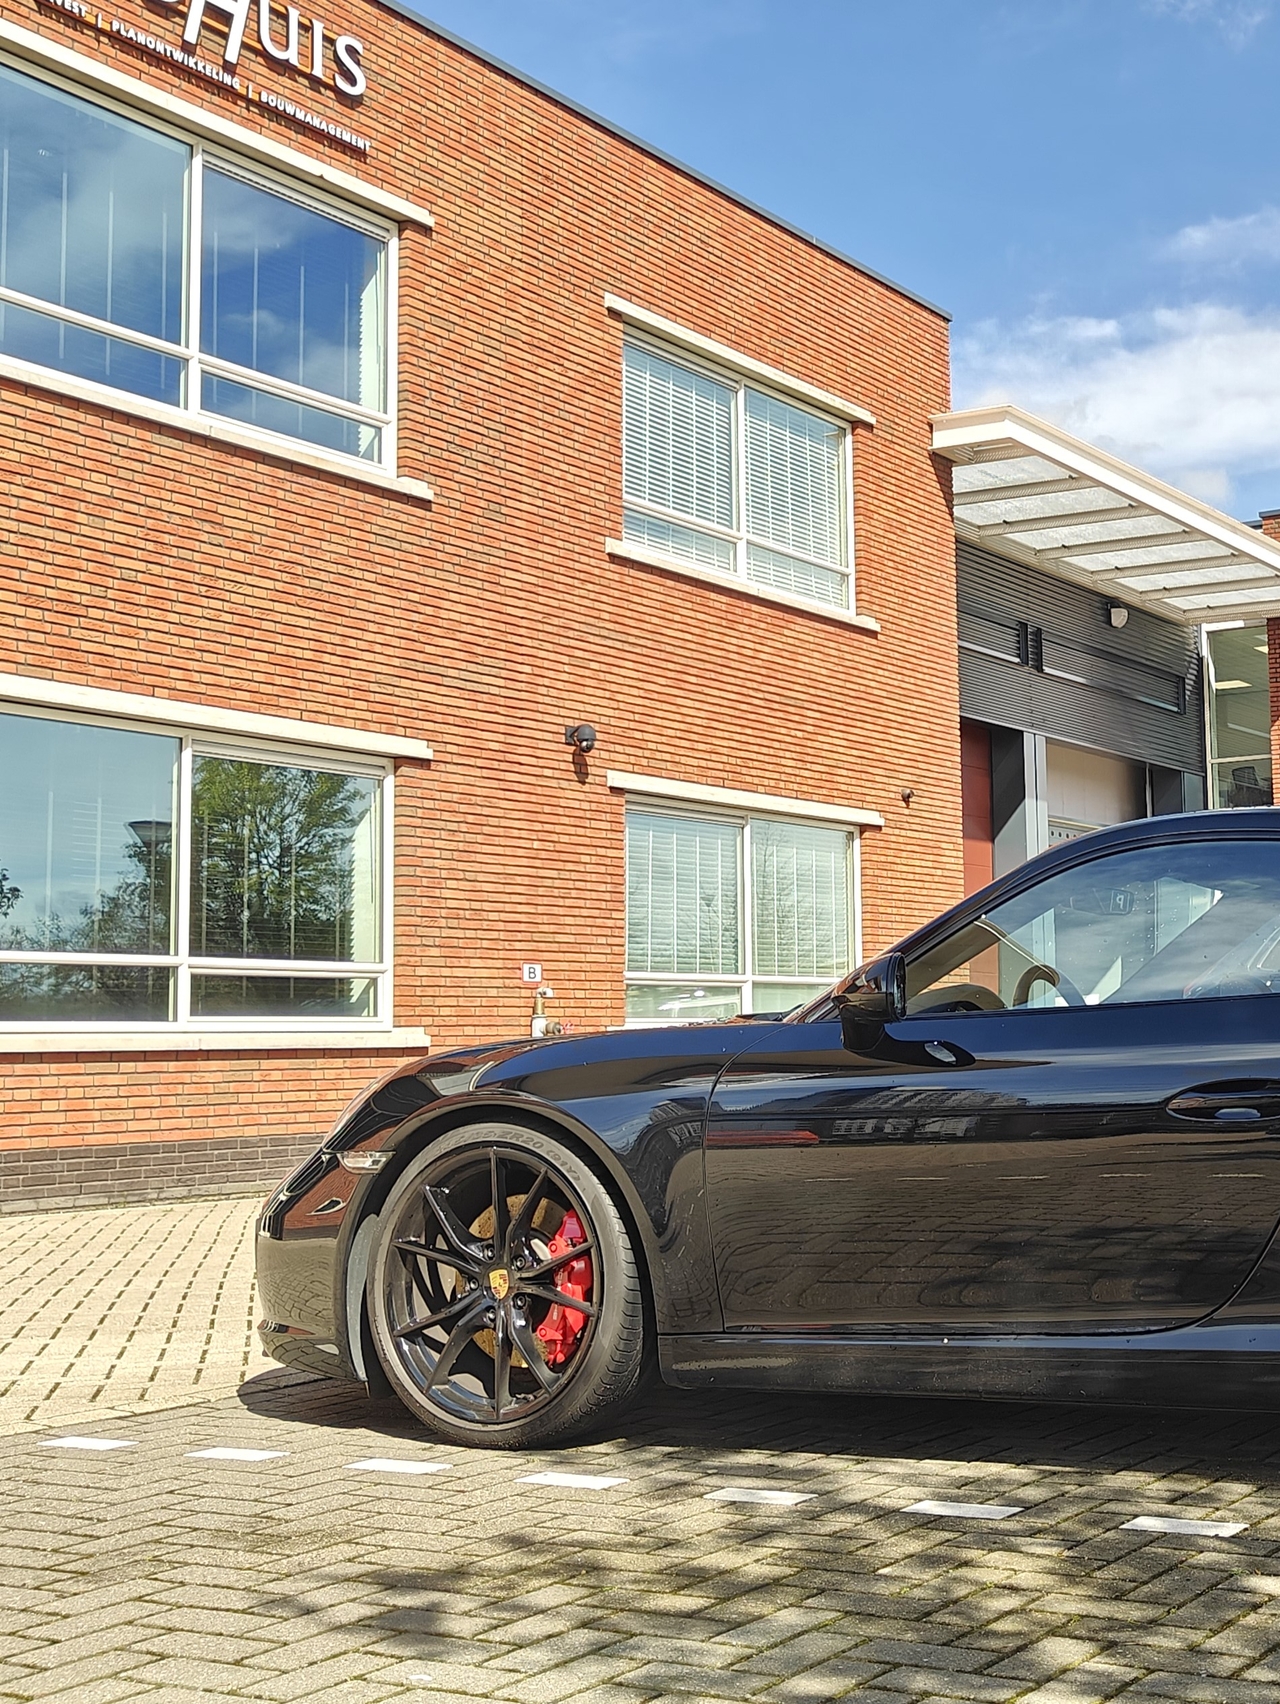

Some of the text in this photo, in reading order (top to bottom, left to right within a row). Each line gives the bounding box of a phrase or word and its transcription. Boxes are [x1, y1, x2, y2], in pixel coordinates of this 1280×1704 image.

[50, 0, 371, 152] VEST PLANONTWIKKELING BOUWMANAGEMENT
[528, 966, 537, 979] B
